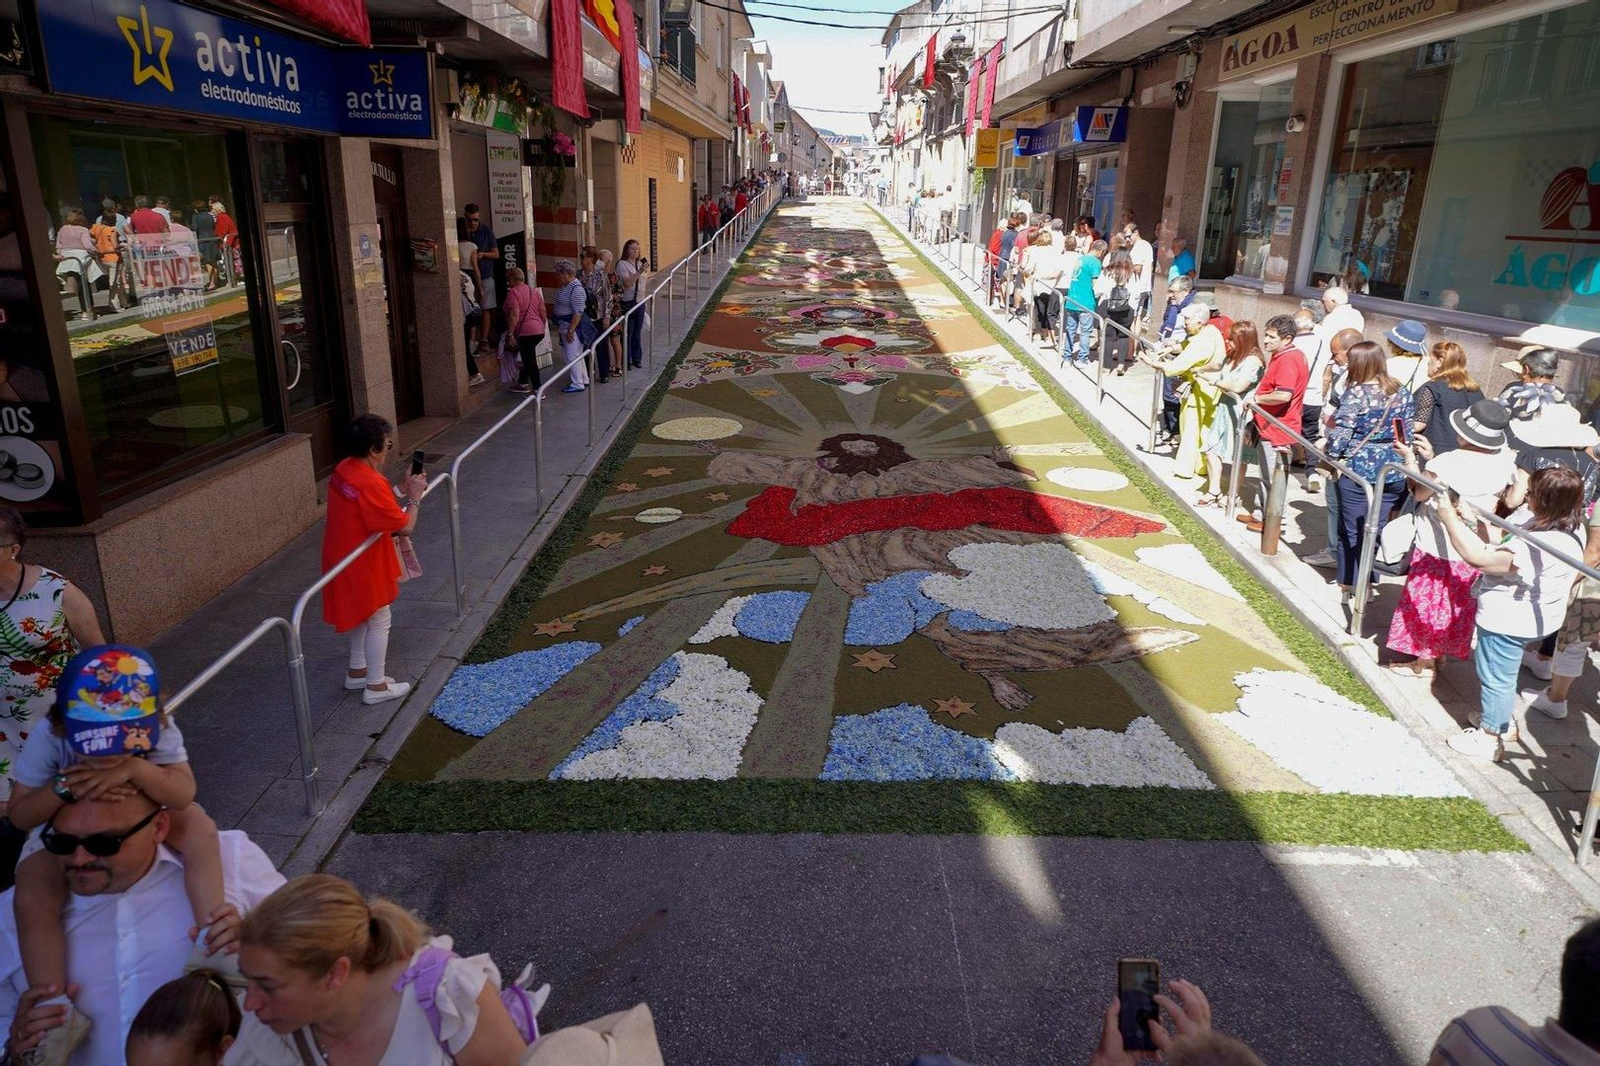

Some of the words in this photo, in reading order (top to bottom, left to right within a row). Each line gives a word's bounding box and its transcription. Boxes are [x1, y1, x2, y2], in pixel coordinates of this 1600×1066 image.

[1312, 0, 1435, 47] PERFECCIONAMENTO
[1339, 0, 1385, 23] CENTRO
[195, 31, 300, 92] activa
[201, 78, 302, 115] electrodomésticos
[346, 88, 423, 112] activa
[348, 110, 423, 121] electrodomésticos
[1090, 128, 1109, 136] FIATC
[133, 254, 201, 288] VENDE
[168, 332, 214, 356] VENDE
[0, 406, 35, 435] OS
[82, 738, 113, 754] FUN!
